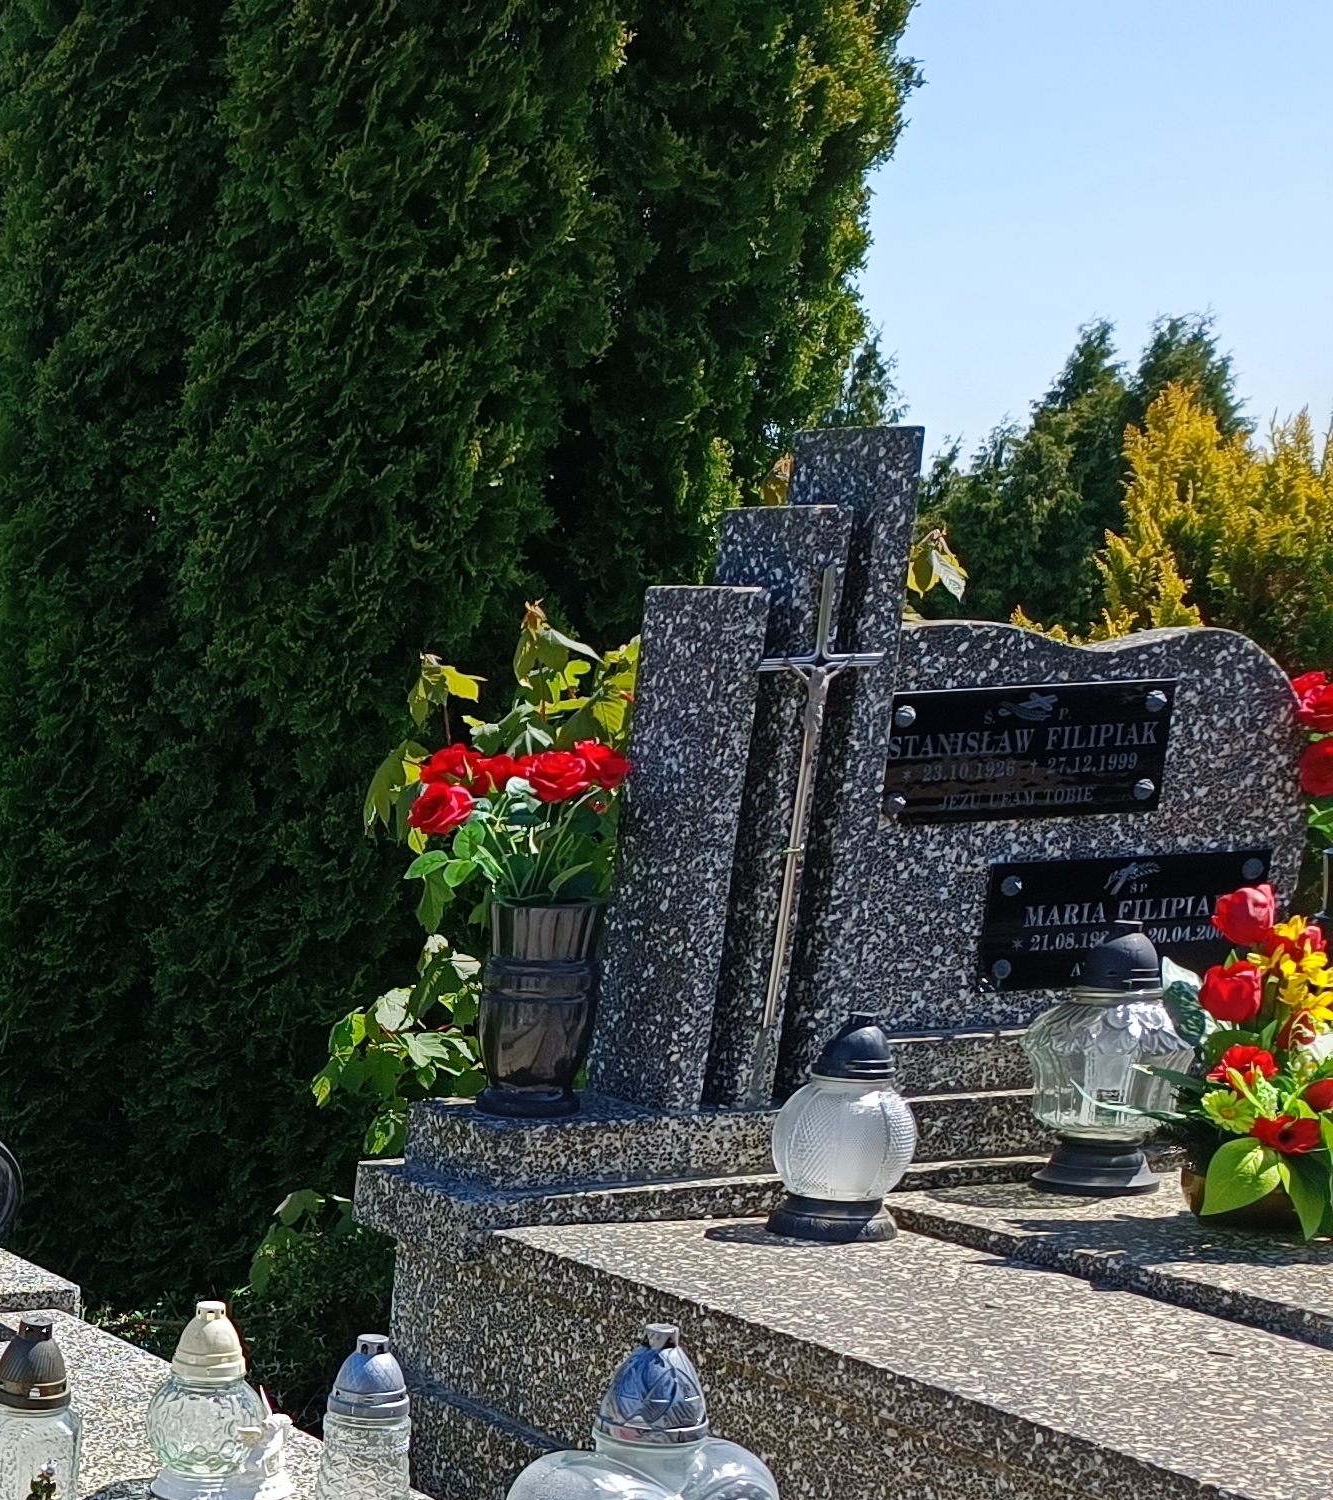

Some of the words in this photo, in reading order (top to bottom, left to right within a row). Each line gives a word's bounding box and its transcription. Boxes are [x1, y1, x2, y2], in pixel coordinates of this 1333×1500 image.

[887, 728, 1035, 760] STANISŁAW
[1044, 721, 1160, 750] FILIPIAK
[921, 760, 1016, 782] 23.10.1926
[1046, 751, 1139, 775] 27.12.1999
[939, 794, 983, 812] JEZU
[989, 789, 1040, 809] UFAM
[1044, 786, 1095, 806] TOBIE
[1023, 902, 1107, 928] MARIA
